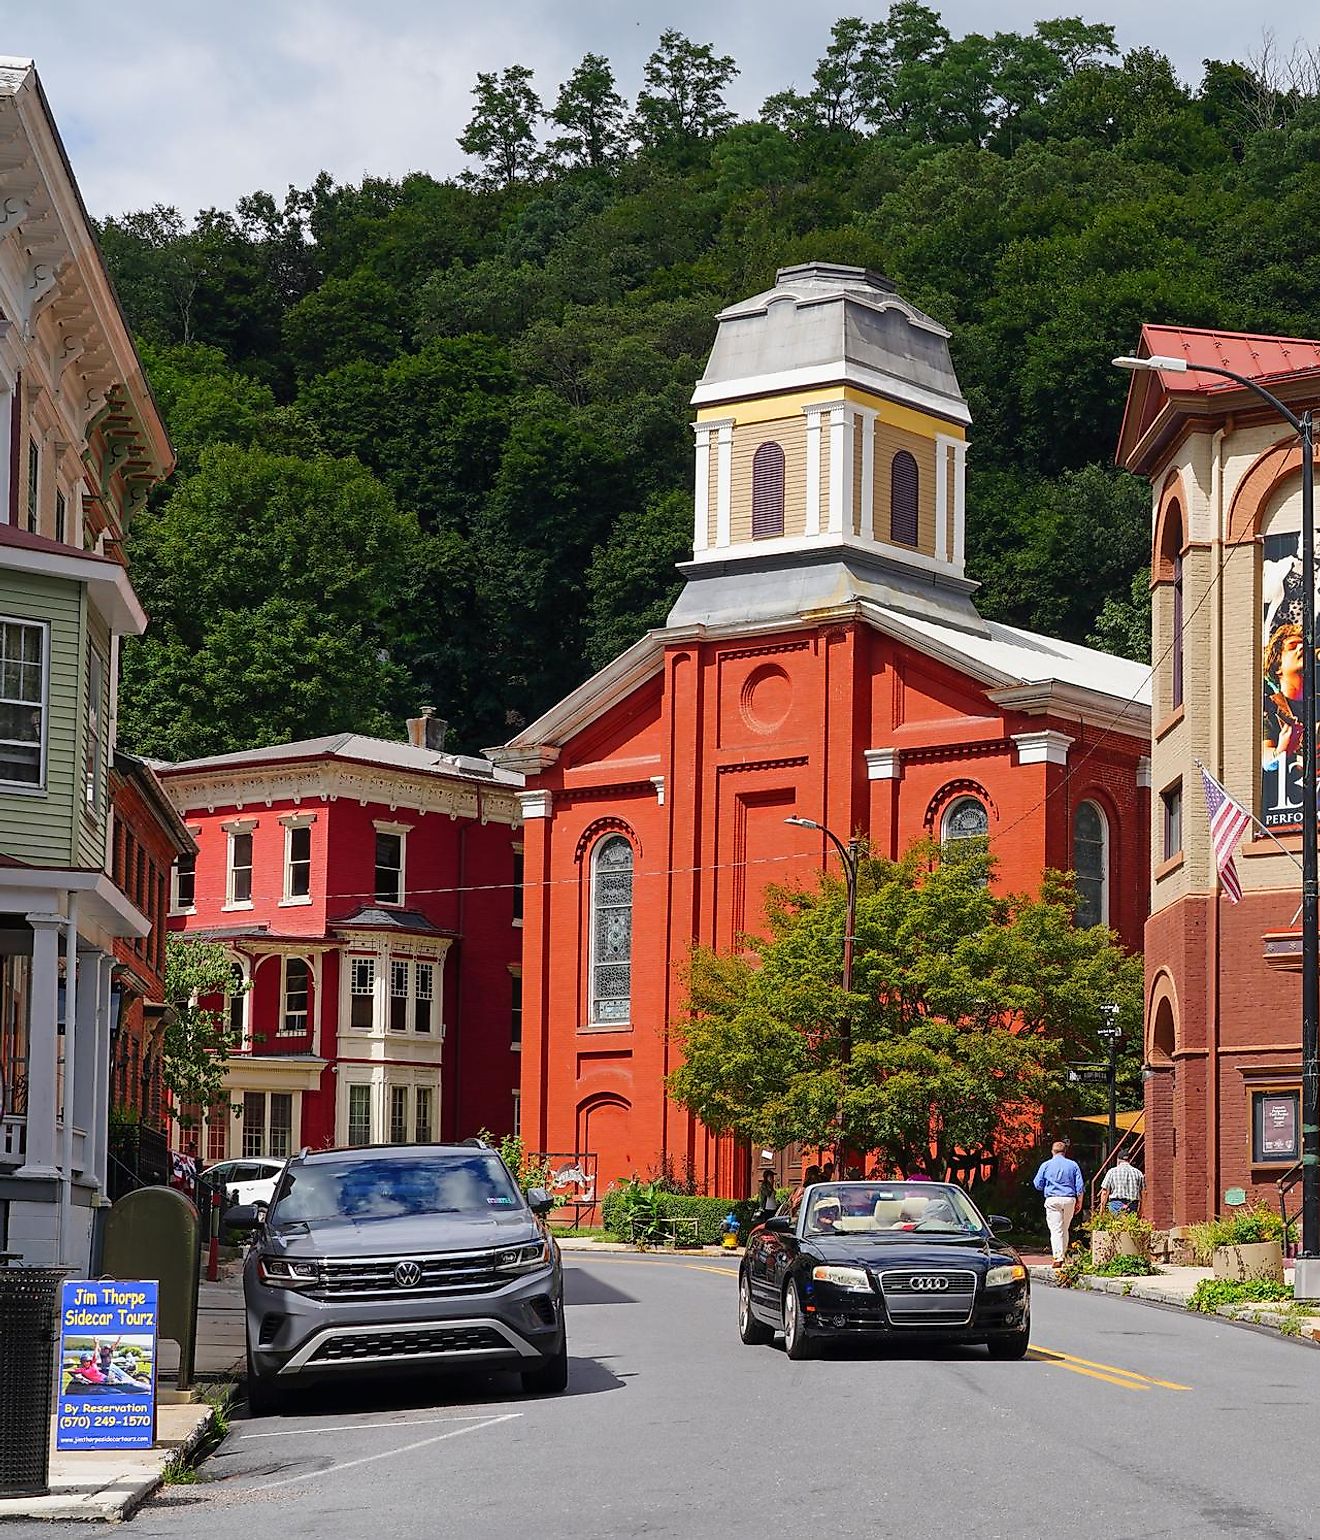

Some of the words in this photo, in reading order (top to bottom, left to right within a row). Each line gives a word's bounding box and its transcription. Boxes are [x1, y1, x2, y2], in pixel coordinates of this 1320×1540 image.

[74, 1289, 97, 1306] Jim
[102, 1289, 146, 1309] Thorpe
[65, 1309, 113, 1326] Sidecar
[118, 1309, 154, 1326] Tourz
[64, 1403, 79, 1416] By
[83, 1403, 148, 1413] Reservation
[60, 1416, 91, 1429] (570)
[94, 1416, 150, 1428] 249-1570
